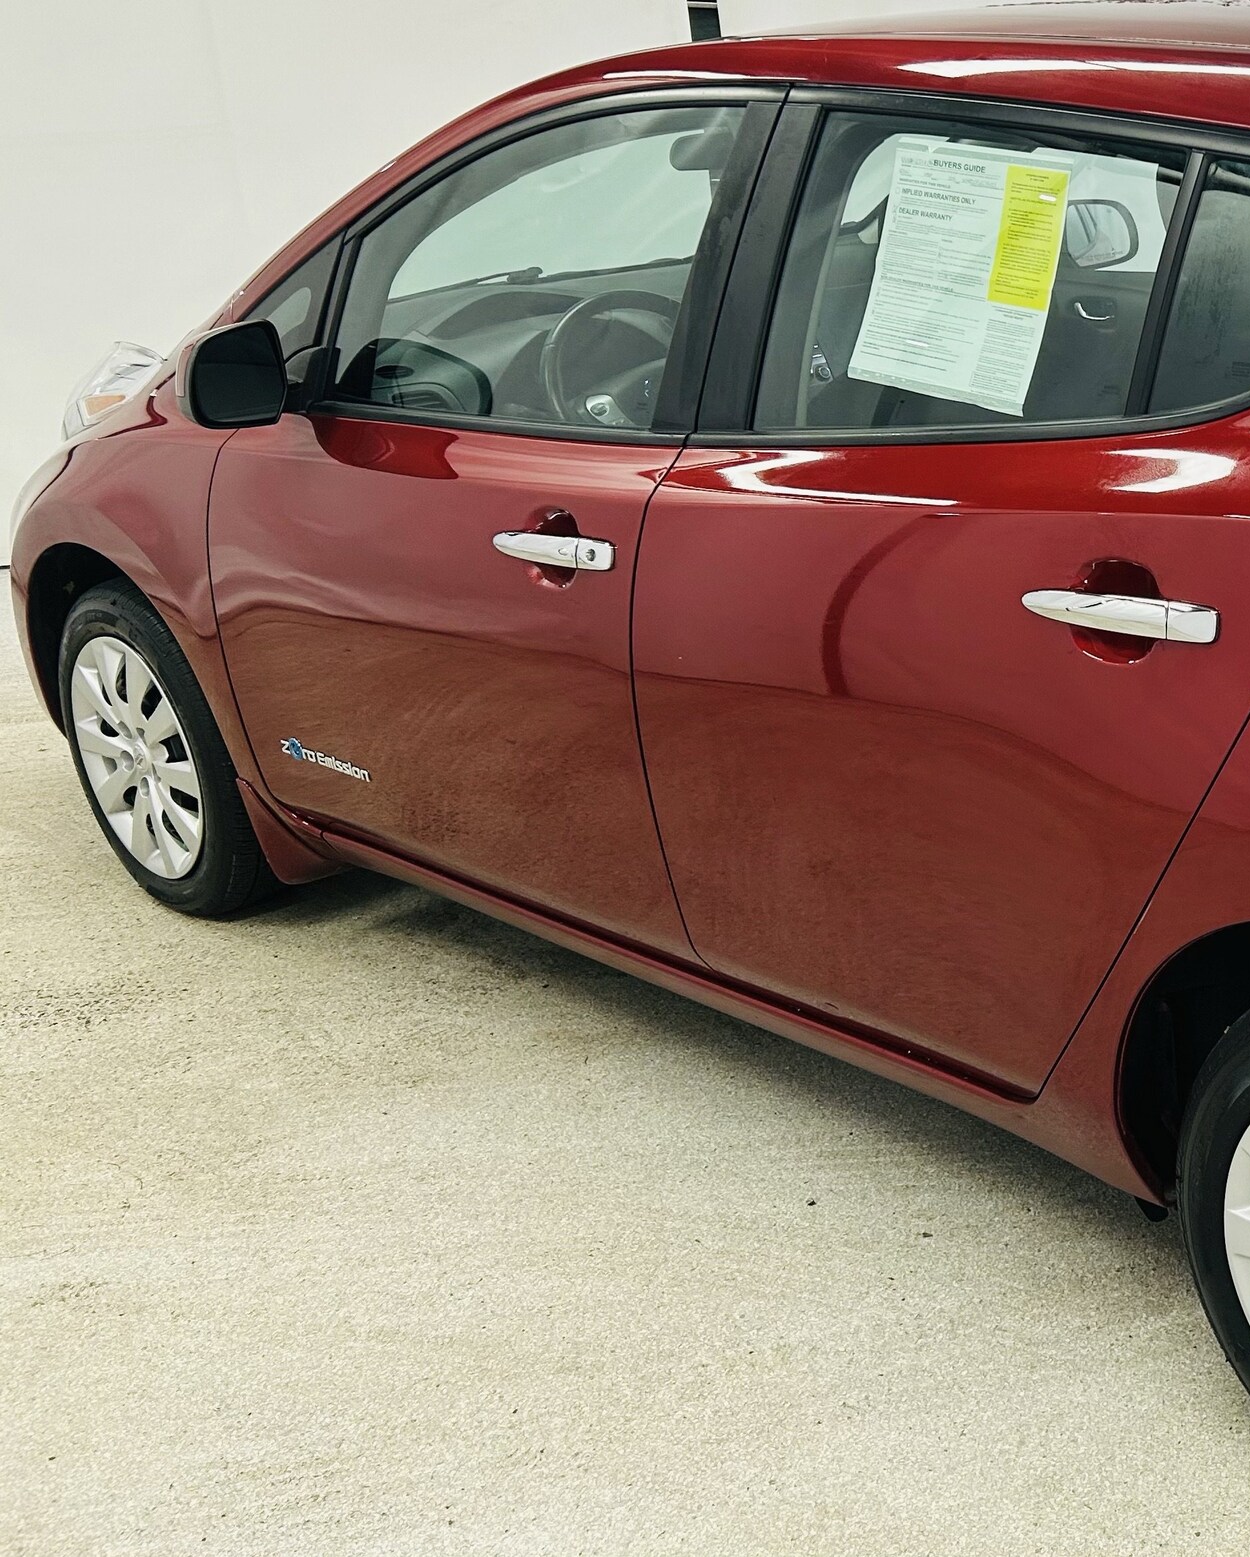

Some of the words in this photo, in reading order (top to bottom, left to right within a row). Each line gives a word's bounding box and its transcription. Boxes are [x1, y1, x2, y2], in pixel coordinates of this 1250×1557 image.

[933, 159, 962, 170] BUYERS
[963, 163, 986, 173] GUIDE
[901, 188, 923, 197] IMPLIED
[923, 191, 961, 203] WARRANTIES
[961, 197, 976, 205] ONLY
[898, 207, 920, 216] DEALER
[920, 210, 953, 221] WARRANTY
[315, 751, 371, 783] Emission
